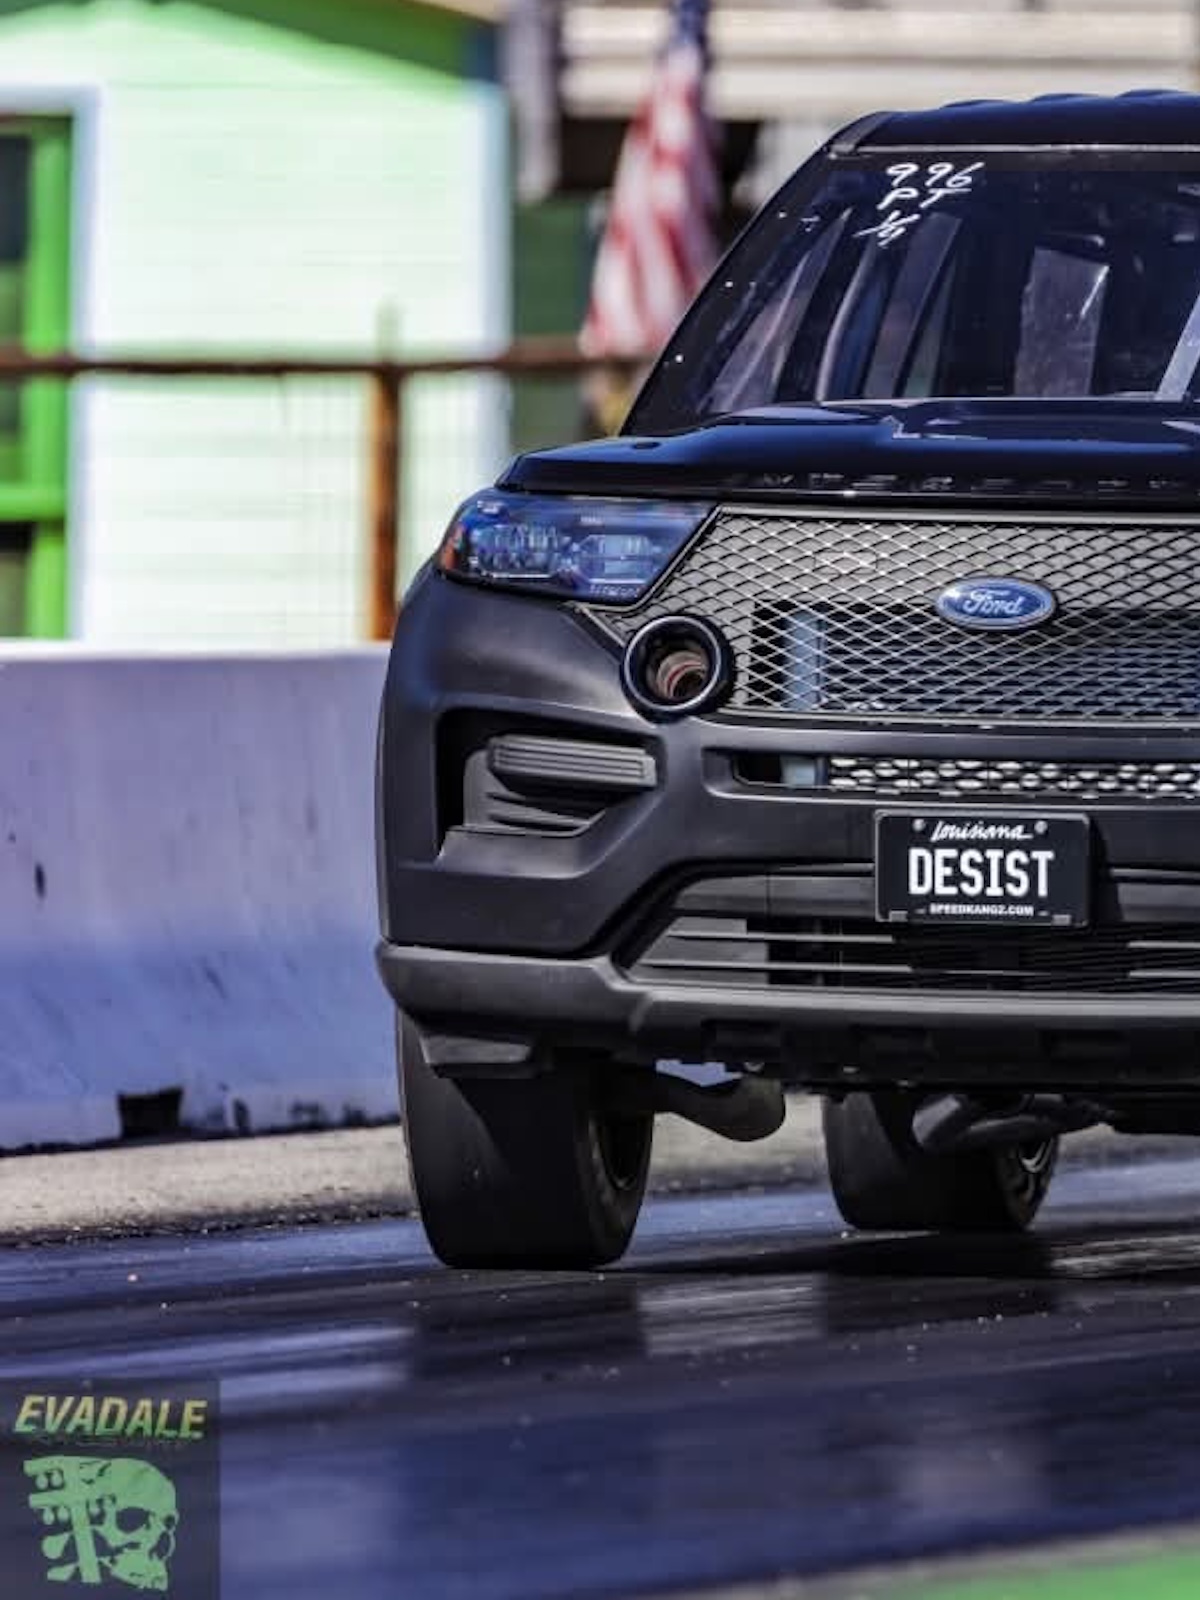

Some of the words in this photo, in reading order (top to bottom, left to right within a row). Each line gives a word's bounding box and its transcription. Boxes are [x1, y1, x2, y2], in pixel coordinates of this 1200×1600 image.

[962, 588, 1026, 615] Ford
[930, 820, 1034, 842] Louisiana
[908, 848, 1055, 897] DESIST
